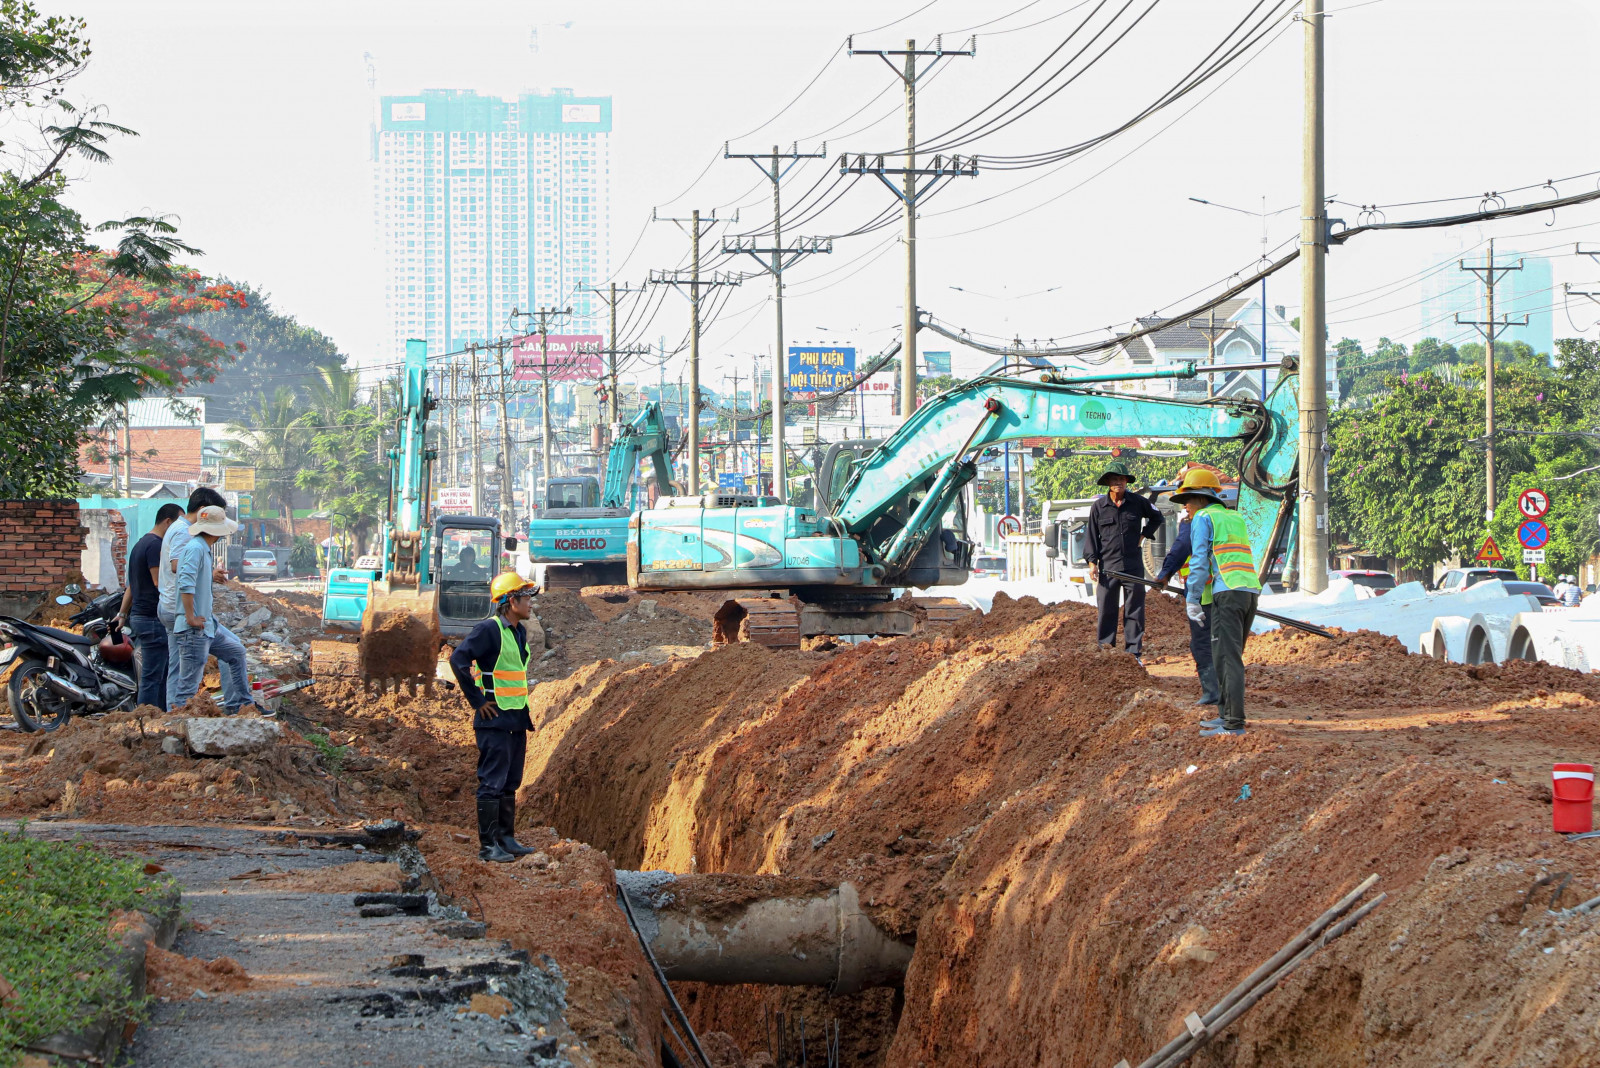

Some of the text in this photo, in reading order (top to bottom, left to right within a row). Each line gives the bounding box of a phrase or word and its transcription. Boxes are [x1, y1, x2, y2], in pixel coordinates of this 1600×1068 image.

[799, 350, 844, 369] PHỤ KIỆN
[790, 371, 807, 390] NỘI
[809, 370, 833, 388] THẤT
[1051, 404, 1076, 421] C11
[1085, 411, 1112, 420] TECHNO
[556, 528, 612, 536] BECAMEX
[555, 538, 606, 550] KOBELCO
[788, 556, 809, 566] U7046
